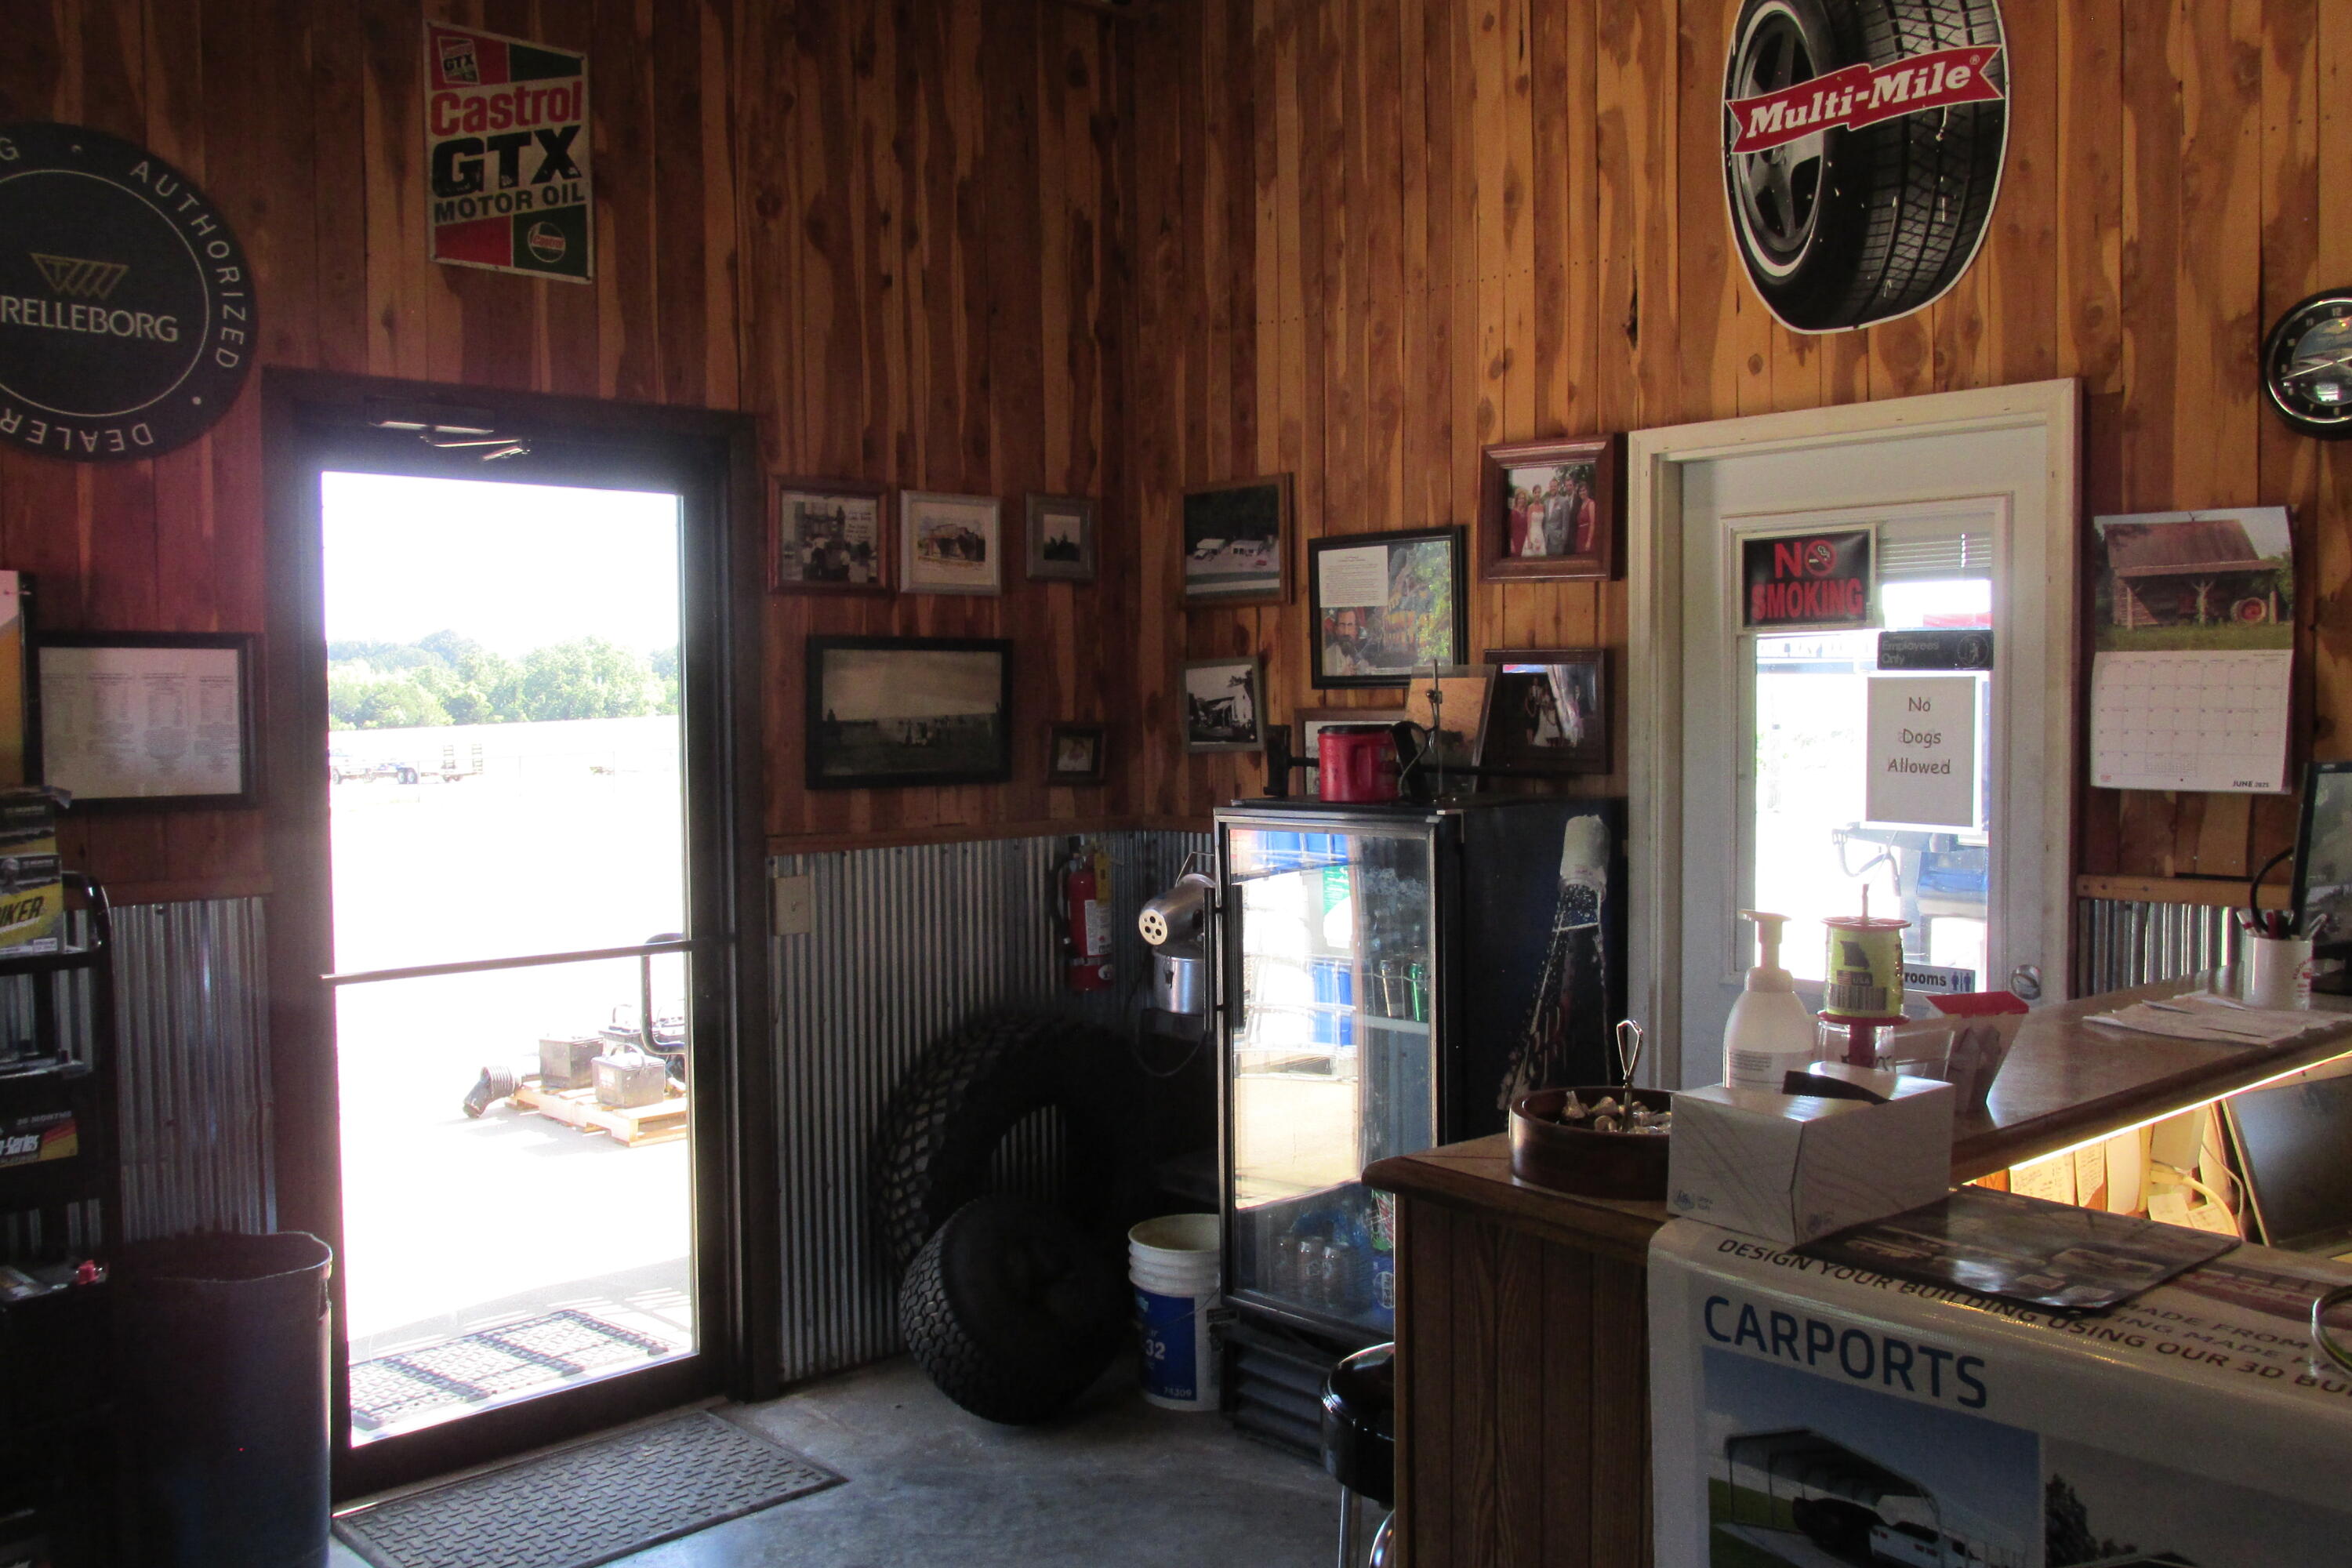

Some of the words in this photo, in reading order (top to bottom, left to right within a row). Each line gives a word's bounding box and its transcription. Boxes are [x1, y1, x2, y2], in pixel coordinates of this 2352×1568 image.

[431, 82, 583, 136] Castrol
[432, 125, 583, 198] GTX
[434, 190, 533, 223] MOTOR
[542, 182, 586, 206] OIL
[129, 160, 246, 368] AUTHORIZED
[0, 408, 155, 453] DEALER
[1751, 577, 1864, 620] SMOKING
[1908, 696, 1931, 712] No
[1902, 728, 1942, 748] Dogs
[1887, 757, 1951, 775] Allowed
[1904, 971, 1947, 987] rooms
[1718, 1239, 1812, 1270] DESIGN
[1820, 1260, 1893, 1289] YOUR
[1899, 1283, 2038, 1323] BUILDING
[2046, 1316, 2147, 1348] USING
[2156, 1341, 2230, 1367] OUR
[2237, 1362, 2285, 1378] 3D
[2294, 1374, 2352, 1396] BU
[2211, 1323, 2310, 1349] FROM
[1704, 1295, 1987, 1410] CARPORTS
